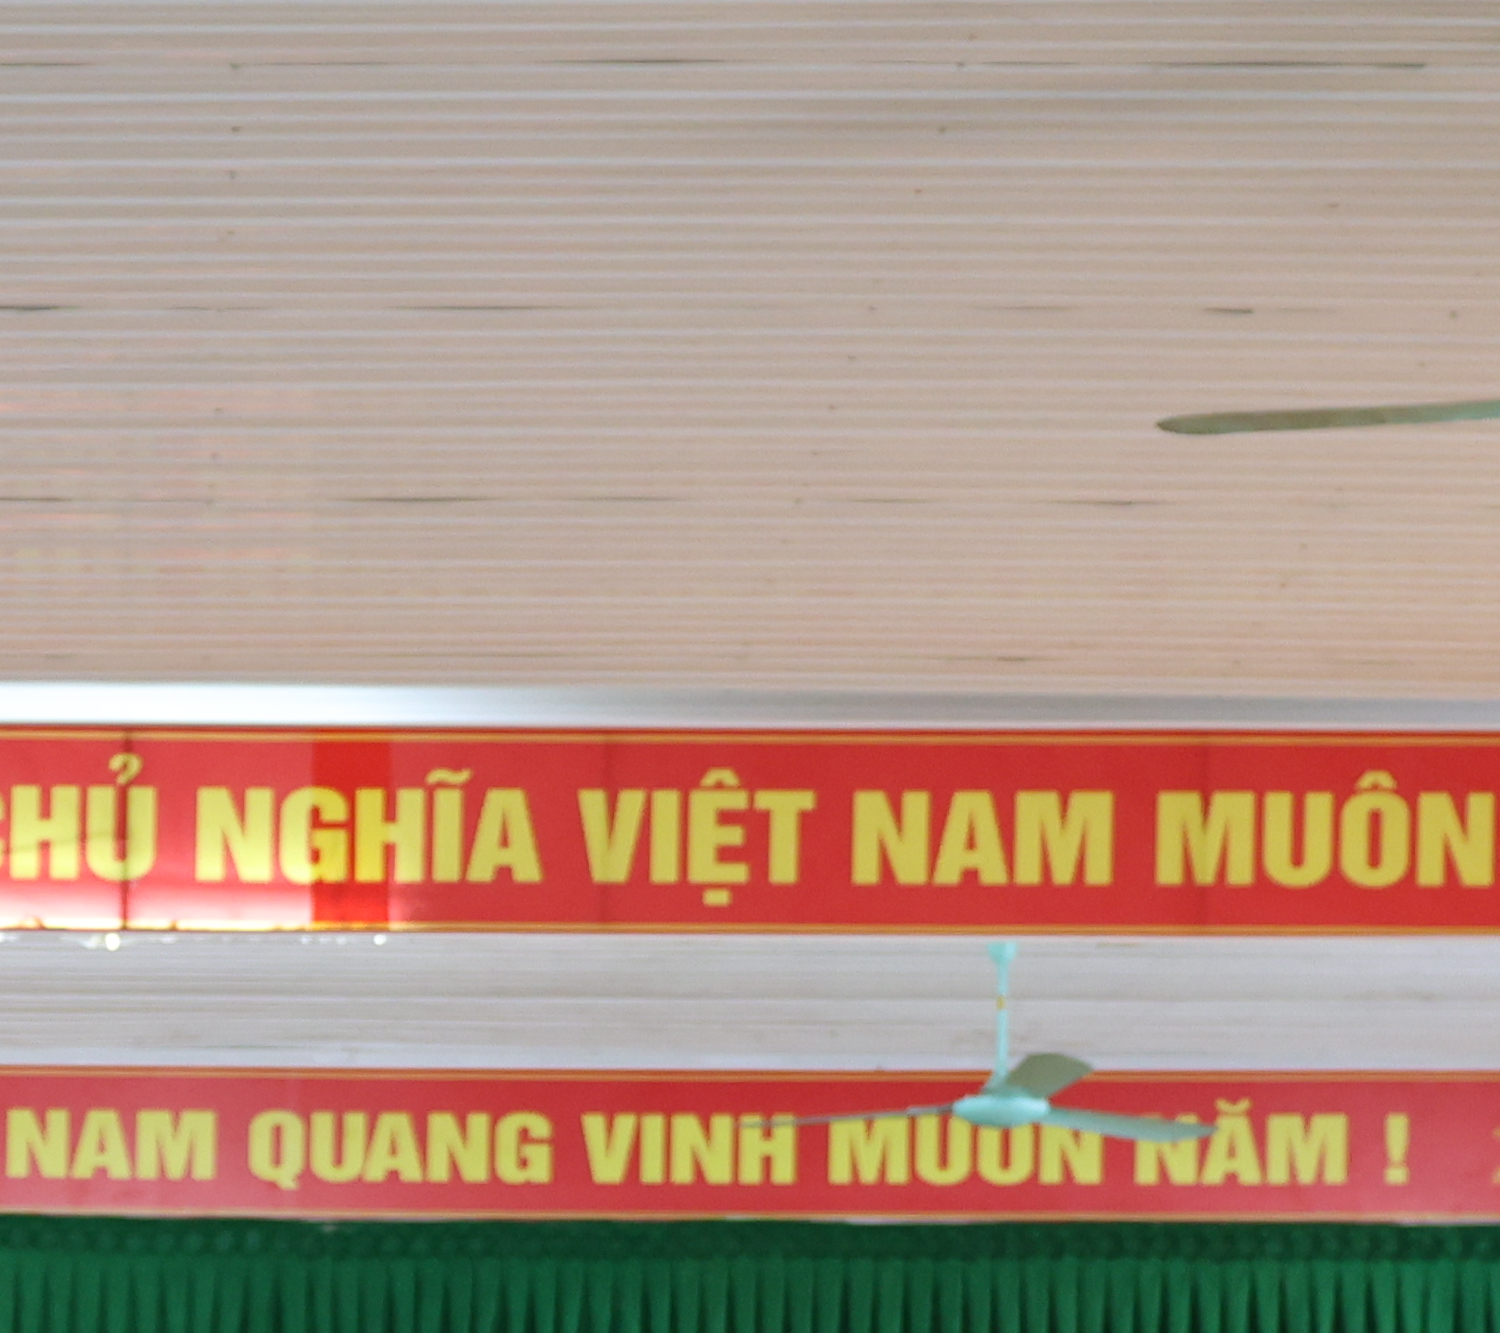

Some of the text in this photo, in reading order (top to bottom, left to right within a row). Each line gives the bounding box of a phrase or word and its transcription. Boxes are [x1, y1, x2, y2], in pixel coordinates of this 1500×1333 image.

[196, 768, 544, 884] NGHĨA
[578, 769, 817, 906] VIỆT
[851, 791, 1115, 887] NAM
[1155, 770, 1496, 888] MUÔN
[6, 1108, 217, 1180] NAM
[249, 1110, 553, 1190] QUANG
[582, 1112, 798, 1185] VINH
[1134, 1098, 1350, 1185] NĂM
[1384, 1112, 1411, 1184] !
